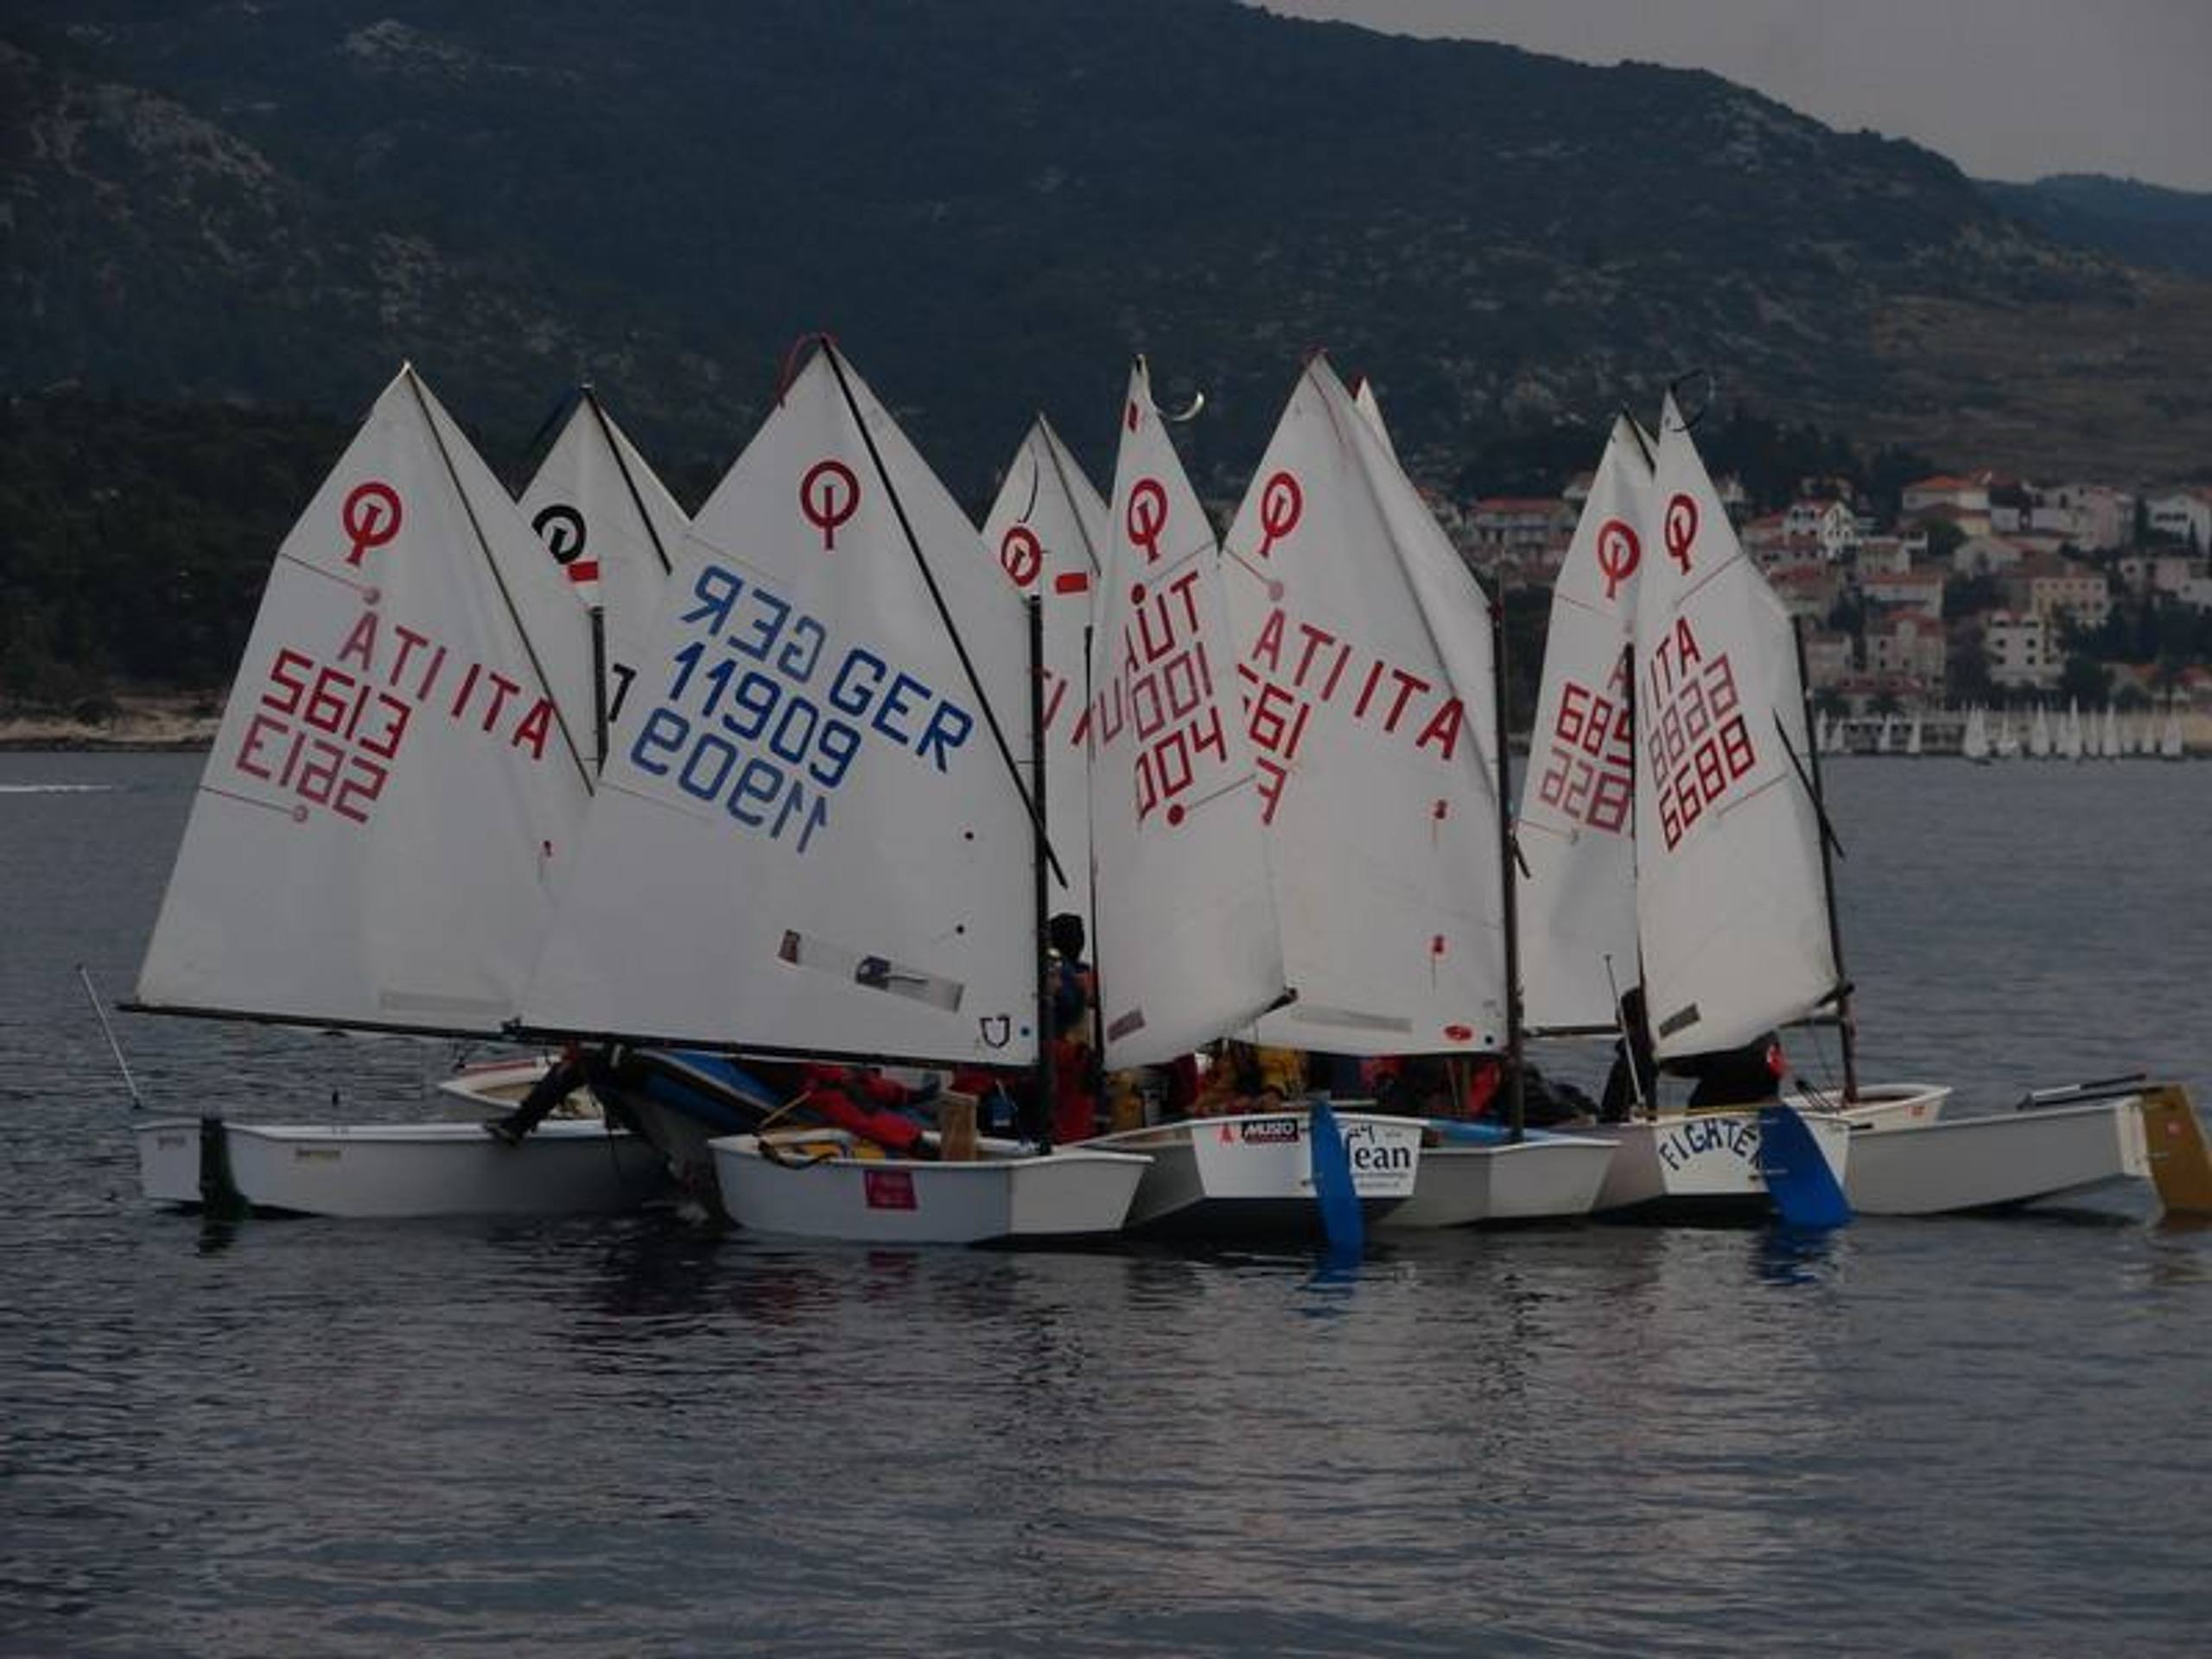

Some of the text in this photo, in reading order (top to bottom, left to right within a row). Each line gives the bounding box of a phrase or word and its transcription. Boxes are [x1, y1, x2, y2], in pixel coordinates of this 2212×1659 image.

[261, 648, 412, 760] 5613
[451, 664, 555, 760] ITA
[669, 640, 861, 788] 11909
[830, 648, 974, 772] GER
[1355, 659, 1465, 760] ITA
[1650, 616, 1700, 709] ITA
[1659, 714, 1757, 852] 6688
[1355, 1146, 1411, 1171] ean
